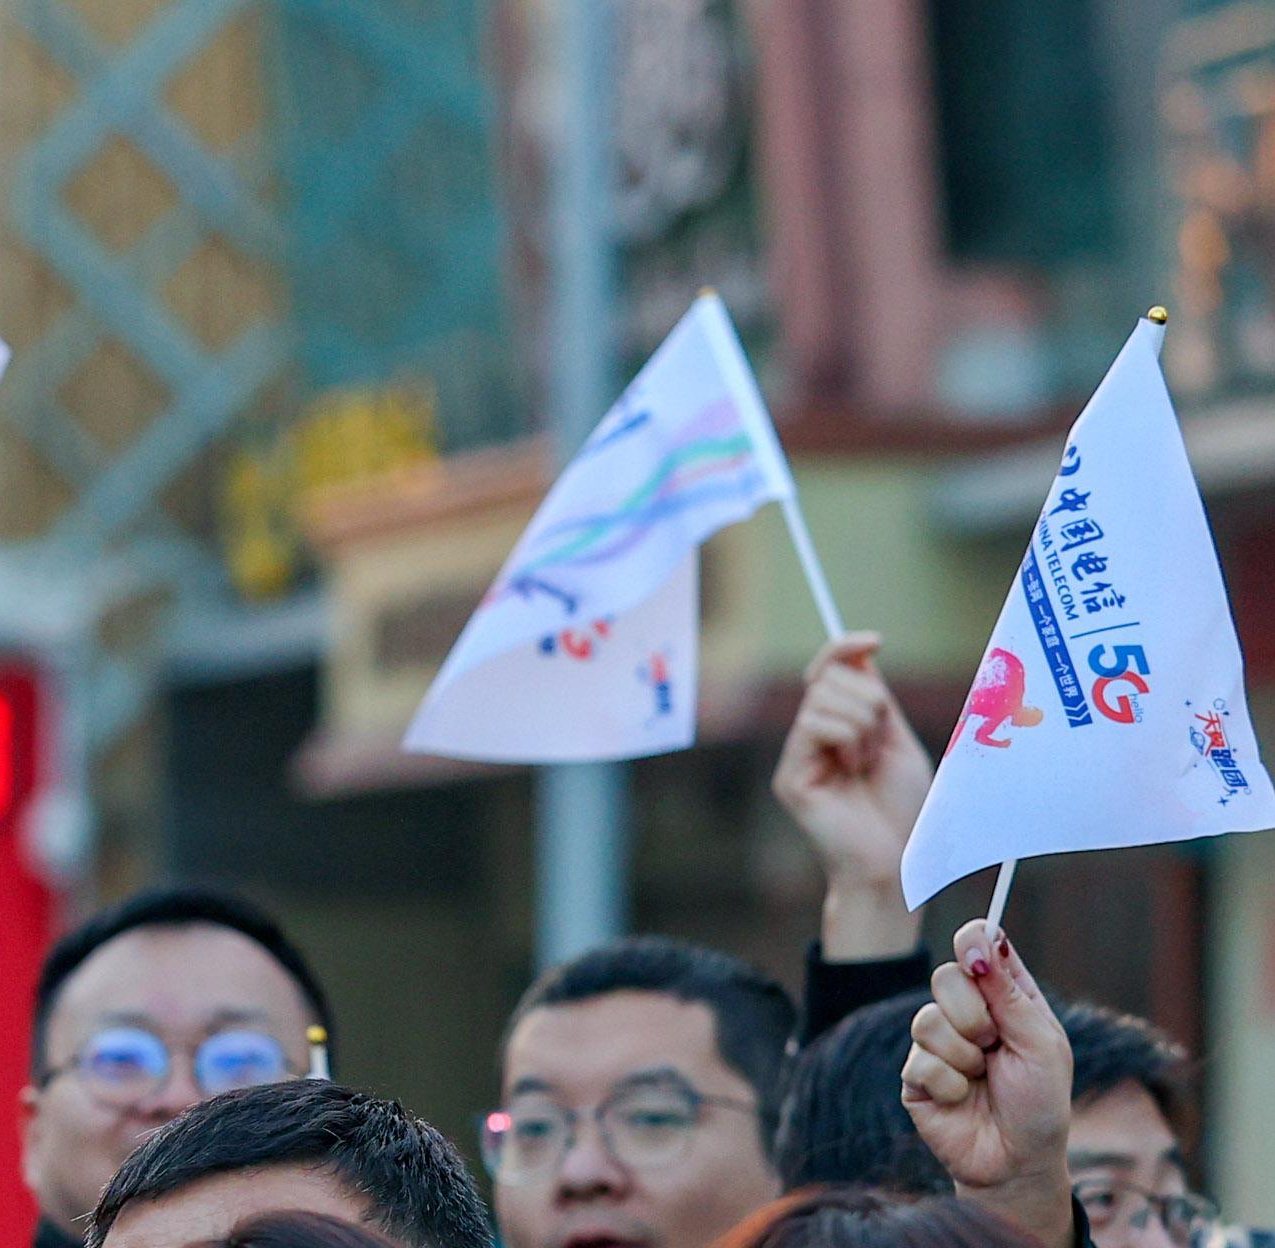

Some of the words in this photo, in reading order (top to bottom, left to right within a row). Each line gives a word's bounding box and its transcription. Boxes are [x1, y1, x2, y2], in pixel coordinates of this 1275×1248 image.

[1043, 488, 1125, 613] 中国电信
[1045, 550, 1079, 620] TELECOM
[1049, 649, 1080, 700] 一个世界
[1087, 643, 1150, 723] 5G
[1196, 711, 1248, 792] 天翼跑团
